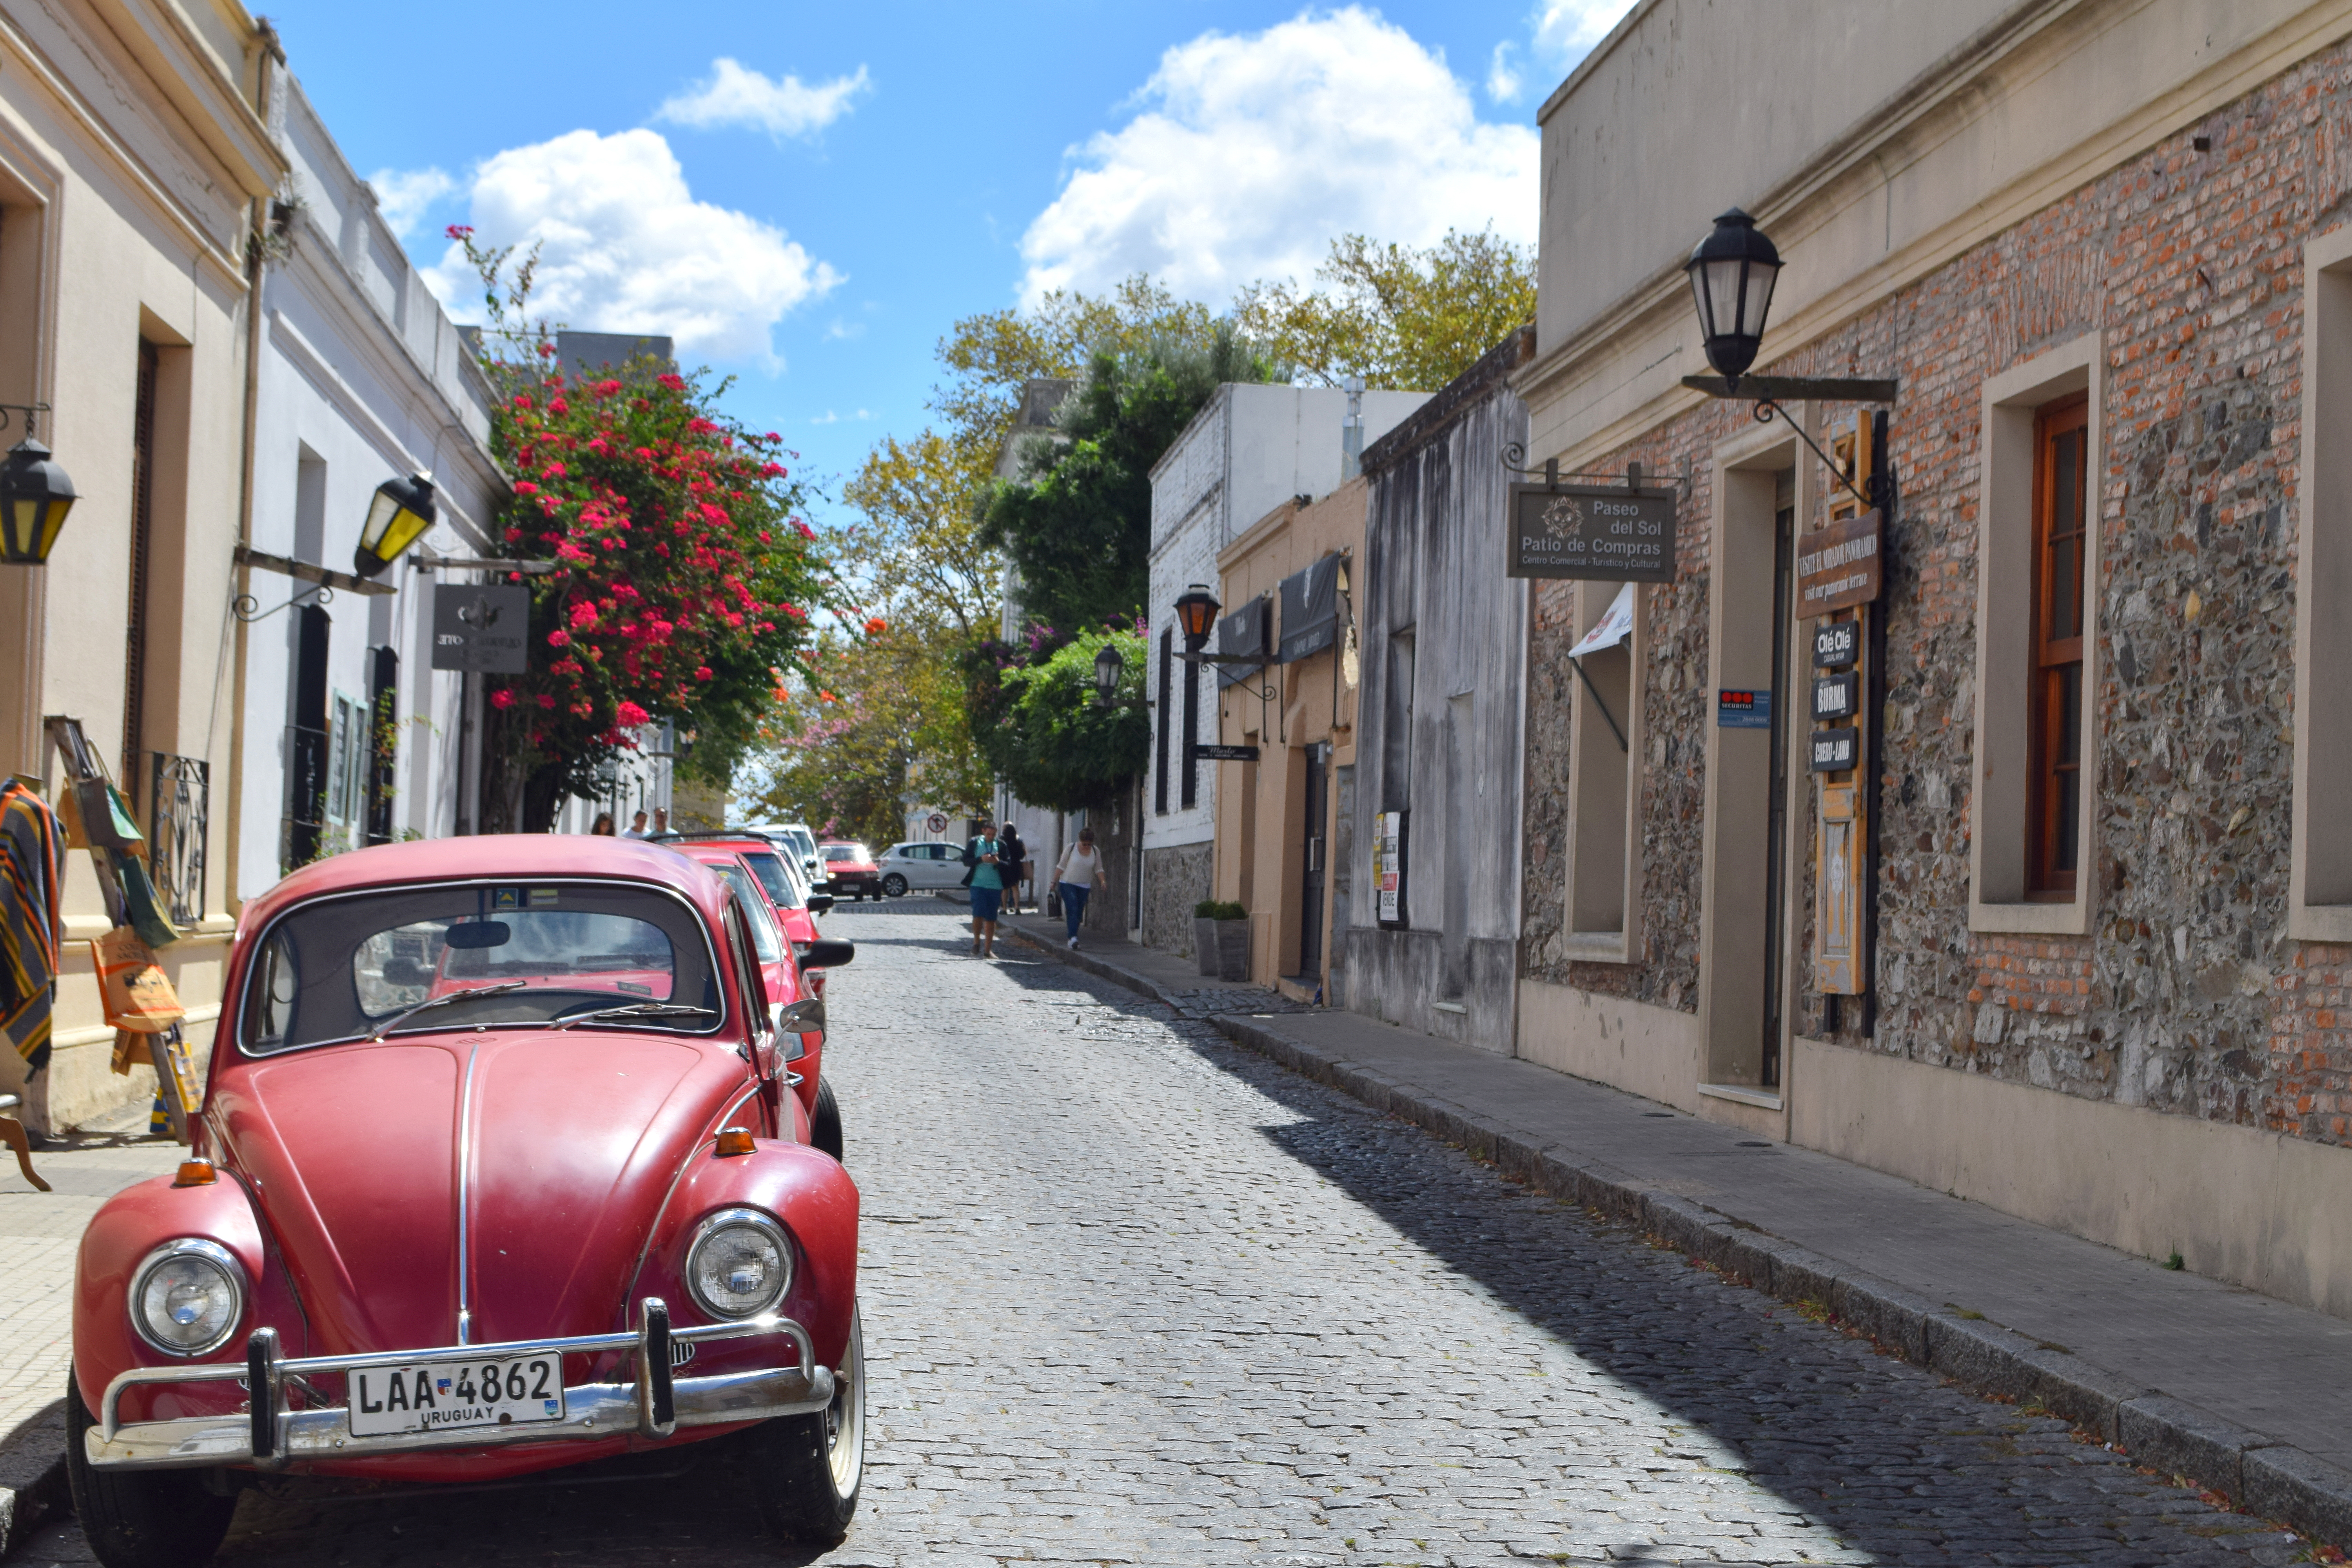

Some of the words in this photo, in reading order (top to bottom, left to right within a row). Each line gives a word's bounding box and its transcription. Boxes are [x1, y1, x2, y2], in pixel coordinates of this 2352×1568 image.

[1594, 501, 1639, 517] Paseo
[1611, 520, 1632, 535] del
[1638, 521, 1661, 535] Sol
[1523, 536, 1561, 552] Patio
[1568, 538, 1585, 552] de
[1593, 539, 1660, 558] Compras
[1799, 554, 1816, 577] VISITE
[1816, 551, 1823, 572] EL
[1823, 544, 1844, 570] MIRADOR
[1845, 534, 1877, 563] PANORAMICO
[1523, 555, 1547, 564] Centro
[1550, 555, 1586, 566] Comercial
[1625, 561, 1629, 570] y
[1631, 559, 1661, 568] Cultural
[1805, 584, 1815, 601] visit
[1816, 584, 1824, 598] our
[1824, 575, 1848, 601] panoramic
[1849, 573, 1867, 589] terrace
[1818, 630, 1834, 653] Olé
[1835, 626, 1851, 650] Olé
[1818, 684, 1846, 713] BURMA
[1815, 742, 1833, 762] CUERO
[1835, 740, 1849, 761] LANA
[359, 1370, 435, 1414] LAA
[456, 1361, 552, 1405] 4862
[421, 1406, 493, 1425] URUGUAY
